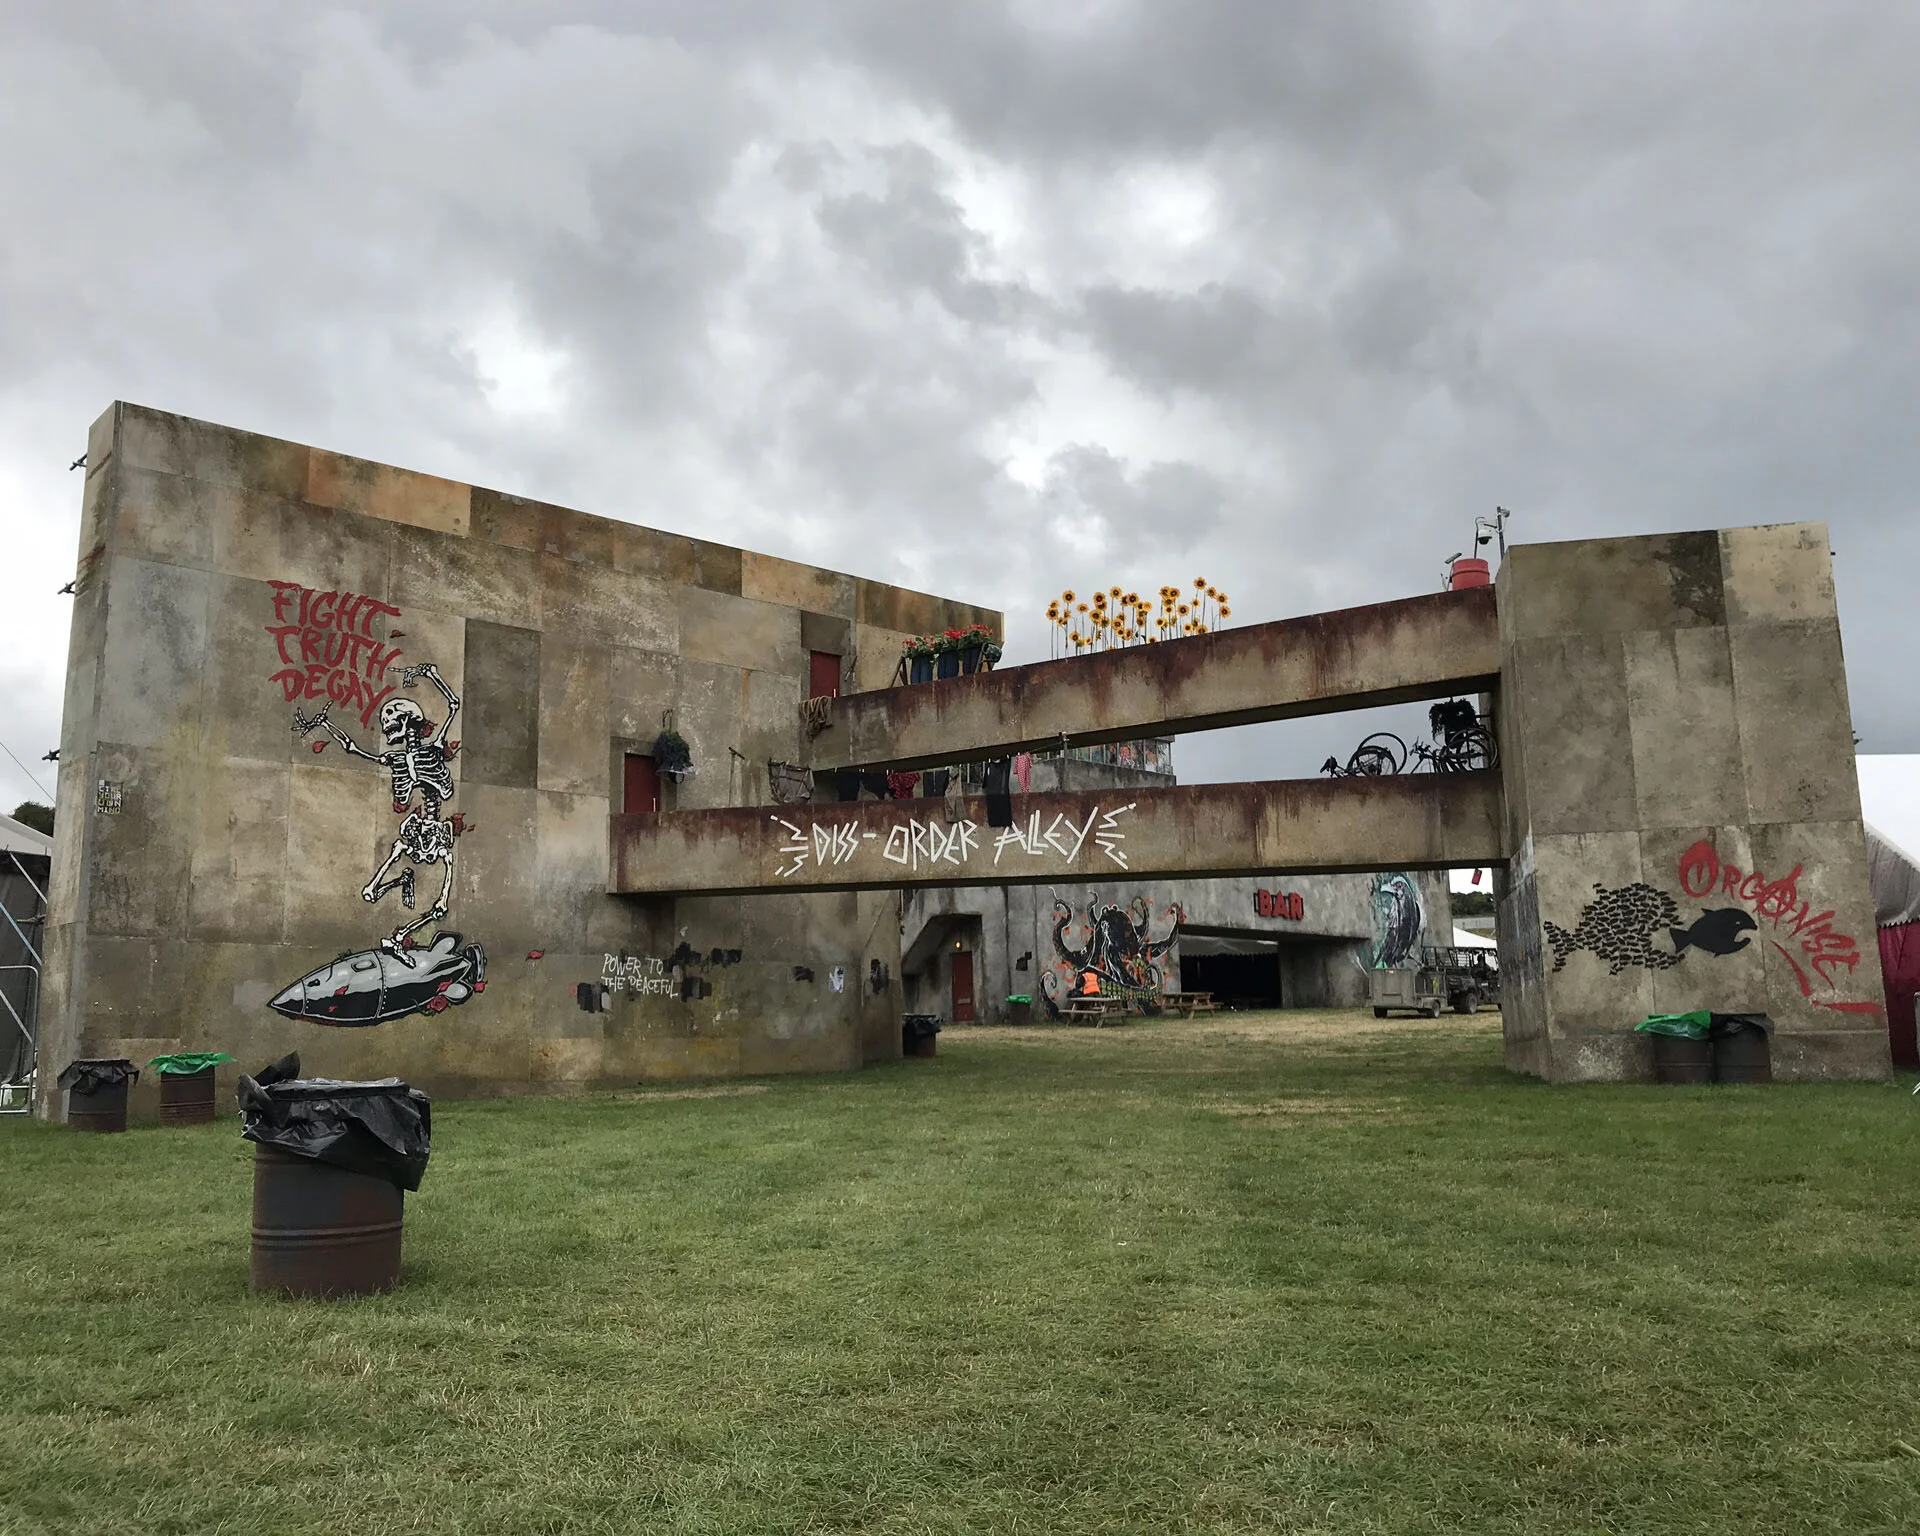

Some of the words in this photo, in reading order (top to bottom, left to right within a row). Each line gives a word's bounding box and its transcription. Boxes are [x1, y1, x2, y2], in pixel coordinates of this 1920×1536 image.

[267, 580, 402, 638] FIGHT
[265, 626, 403, 682] TRUTH
[993, 806, 1099, 866] ALLEY
[1255, 888, 1304, 920] BAR
[601, 976, 626, 992] THE
[628, 975, 679, 999] PEACEFUL
[602, 953, 641, 979] POWER
[645, 957, 664, 976] TO
